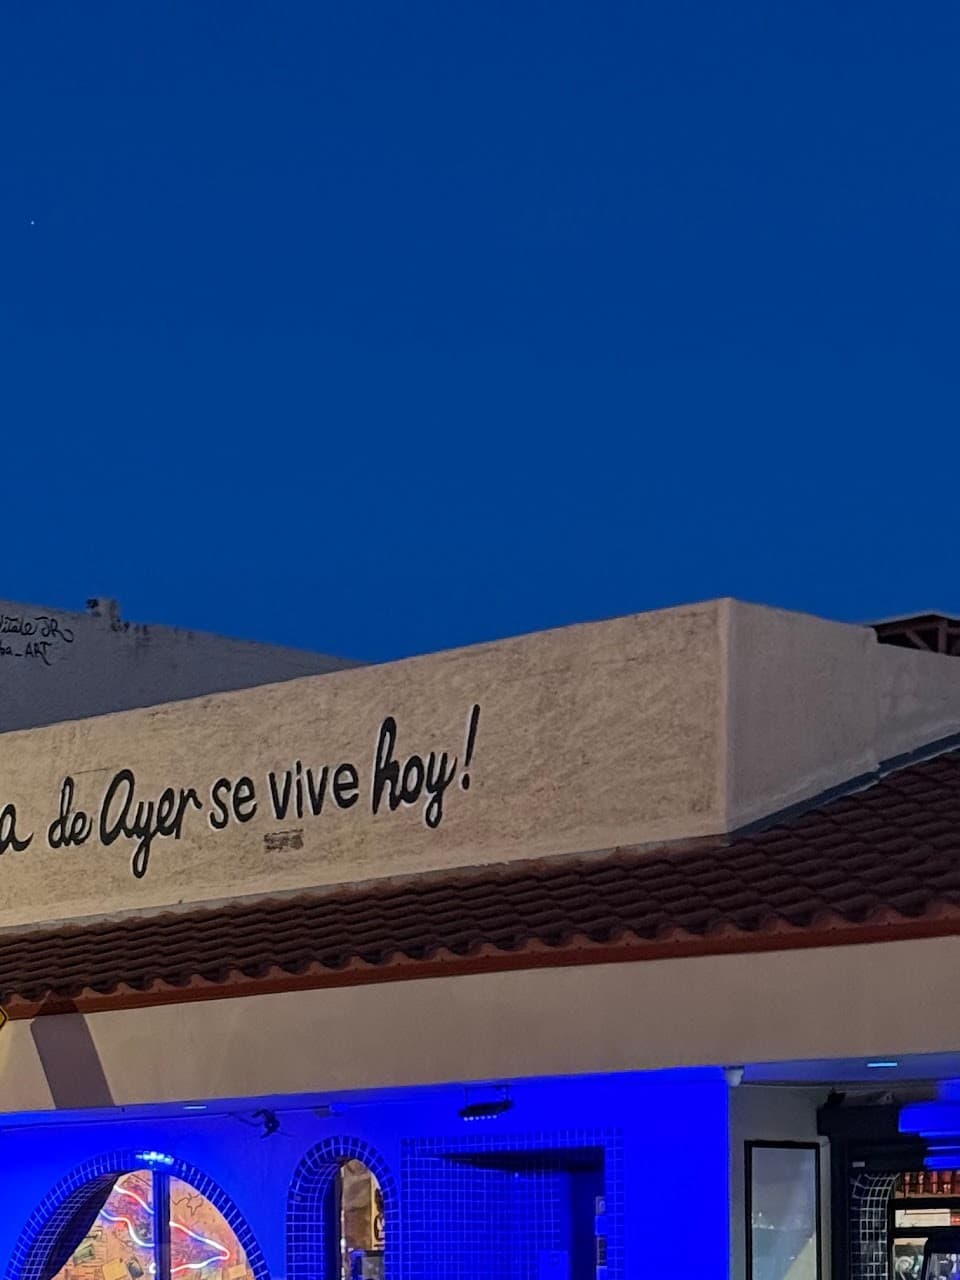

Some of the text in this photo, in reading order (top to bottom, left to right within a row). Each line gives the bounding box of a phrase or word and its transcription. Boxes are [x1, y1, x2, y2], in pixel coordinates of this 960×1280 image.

[48, 776, 92, 848] de
[100, 769, 203, 878] Ayer
[210, 777, 258, 829] se
[268, 760, 359, 820] vive
[372, 703, 481, 829] hoy!
